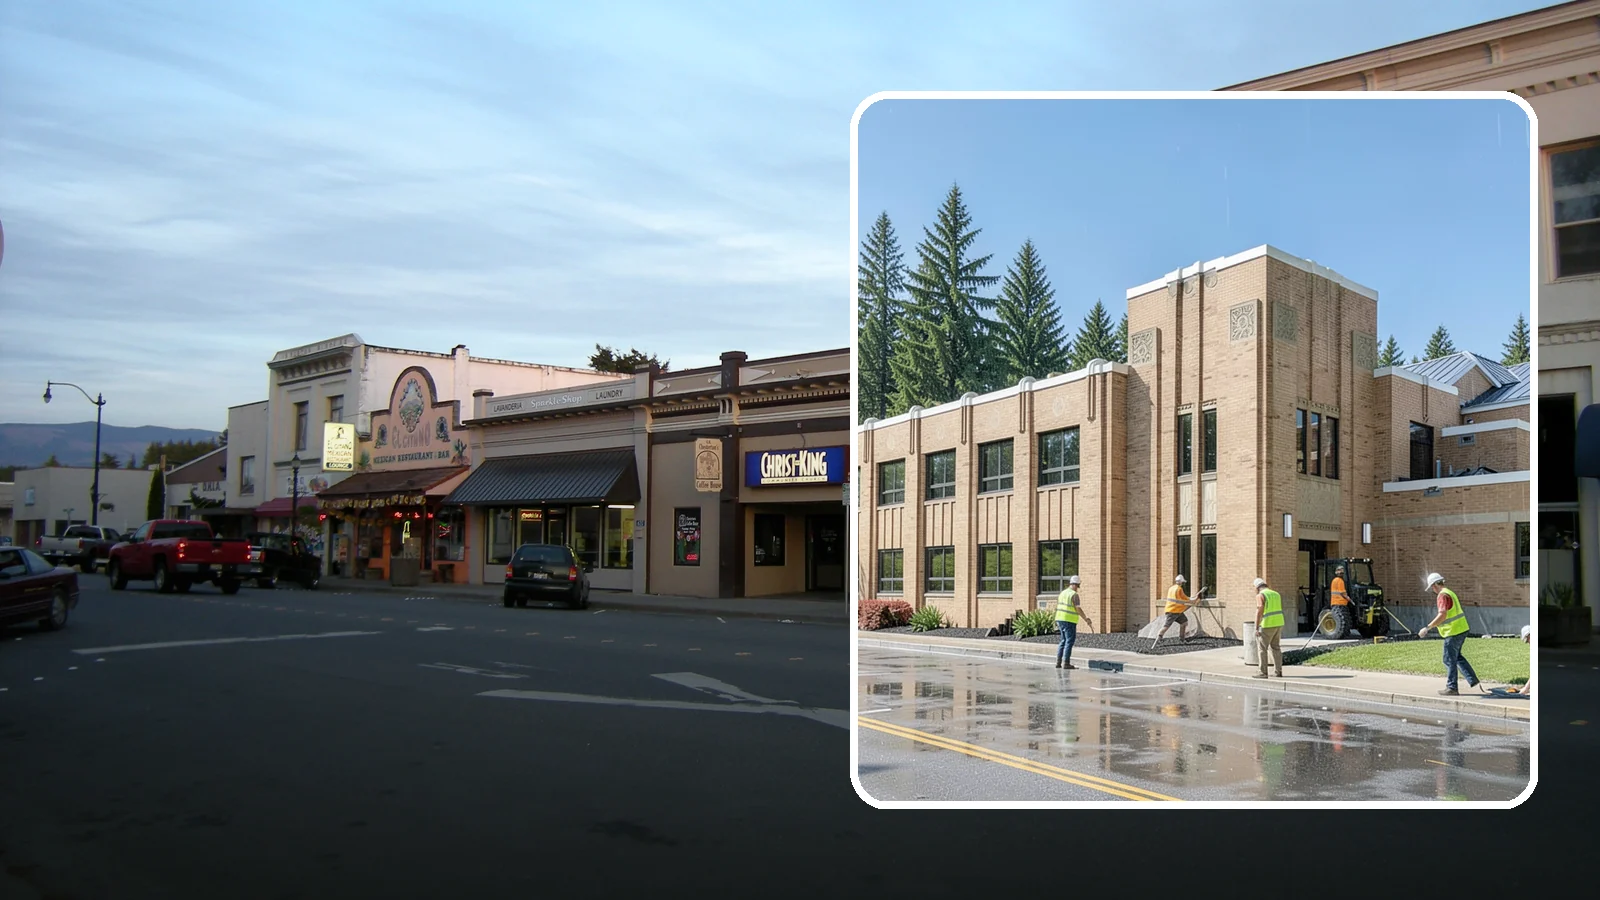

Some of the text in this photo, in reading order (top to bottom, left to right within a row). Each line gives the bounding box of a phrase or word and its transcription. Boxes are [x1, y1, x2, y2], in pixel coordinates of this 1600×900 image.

[530, 394, 583, 409] Sparkle Shop
[595, 389, 623, 400] LAUNDRY
[493, 402, 522, 413] LAVANDERIA
[391, 426, 402, 449] EL
[373, 454, 396, 464] MEXICAN
[397, 451, 433, 462] RESTAURANT
[438, 450, 450, 459] BAR
[761, 450, 828, 478] CHRIST KING
[697, 481, 709, 489] Coffee
